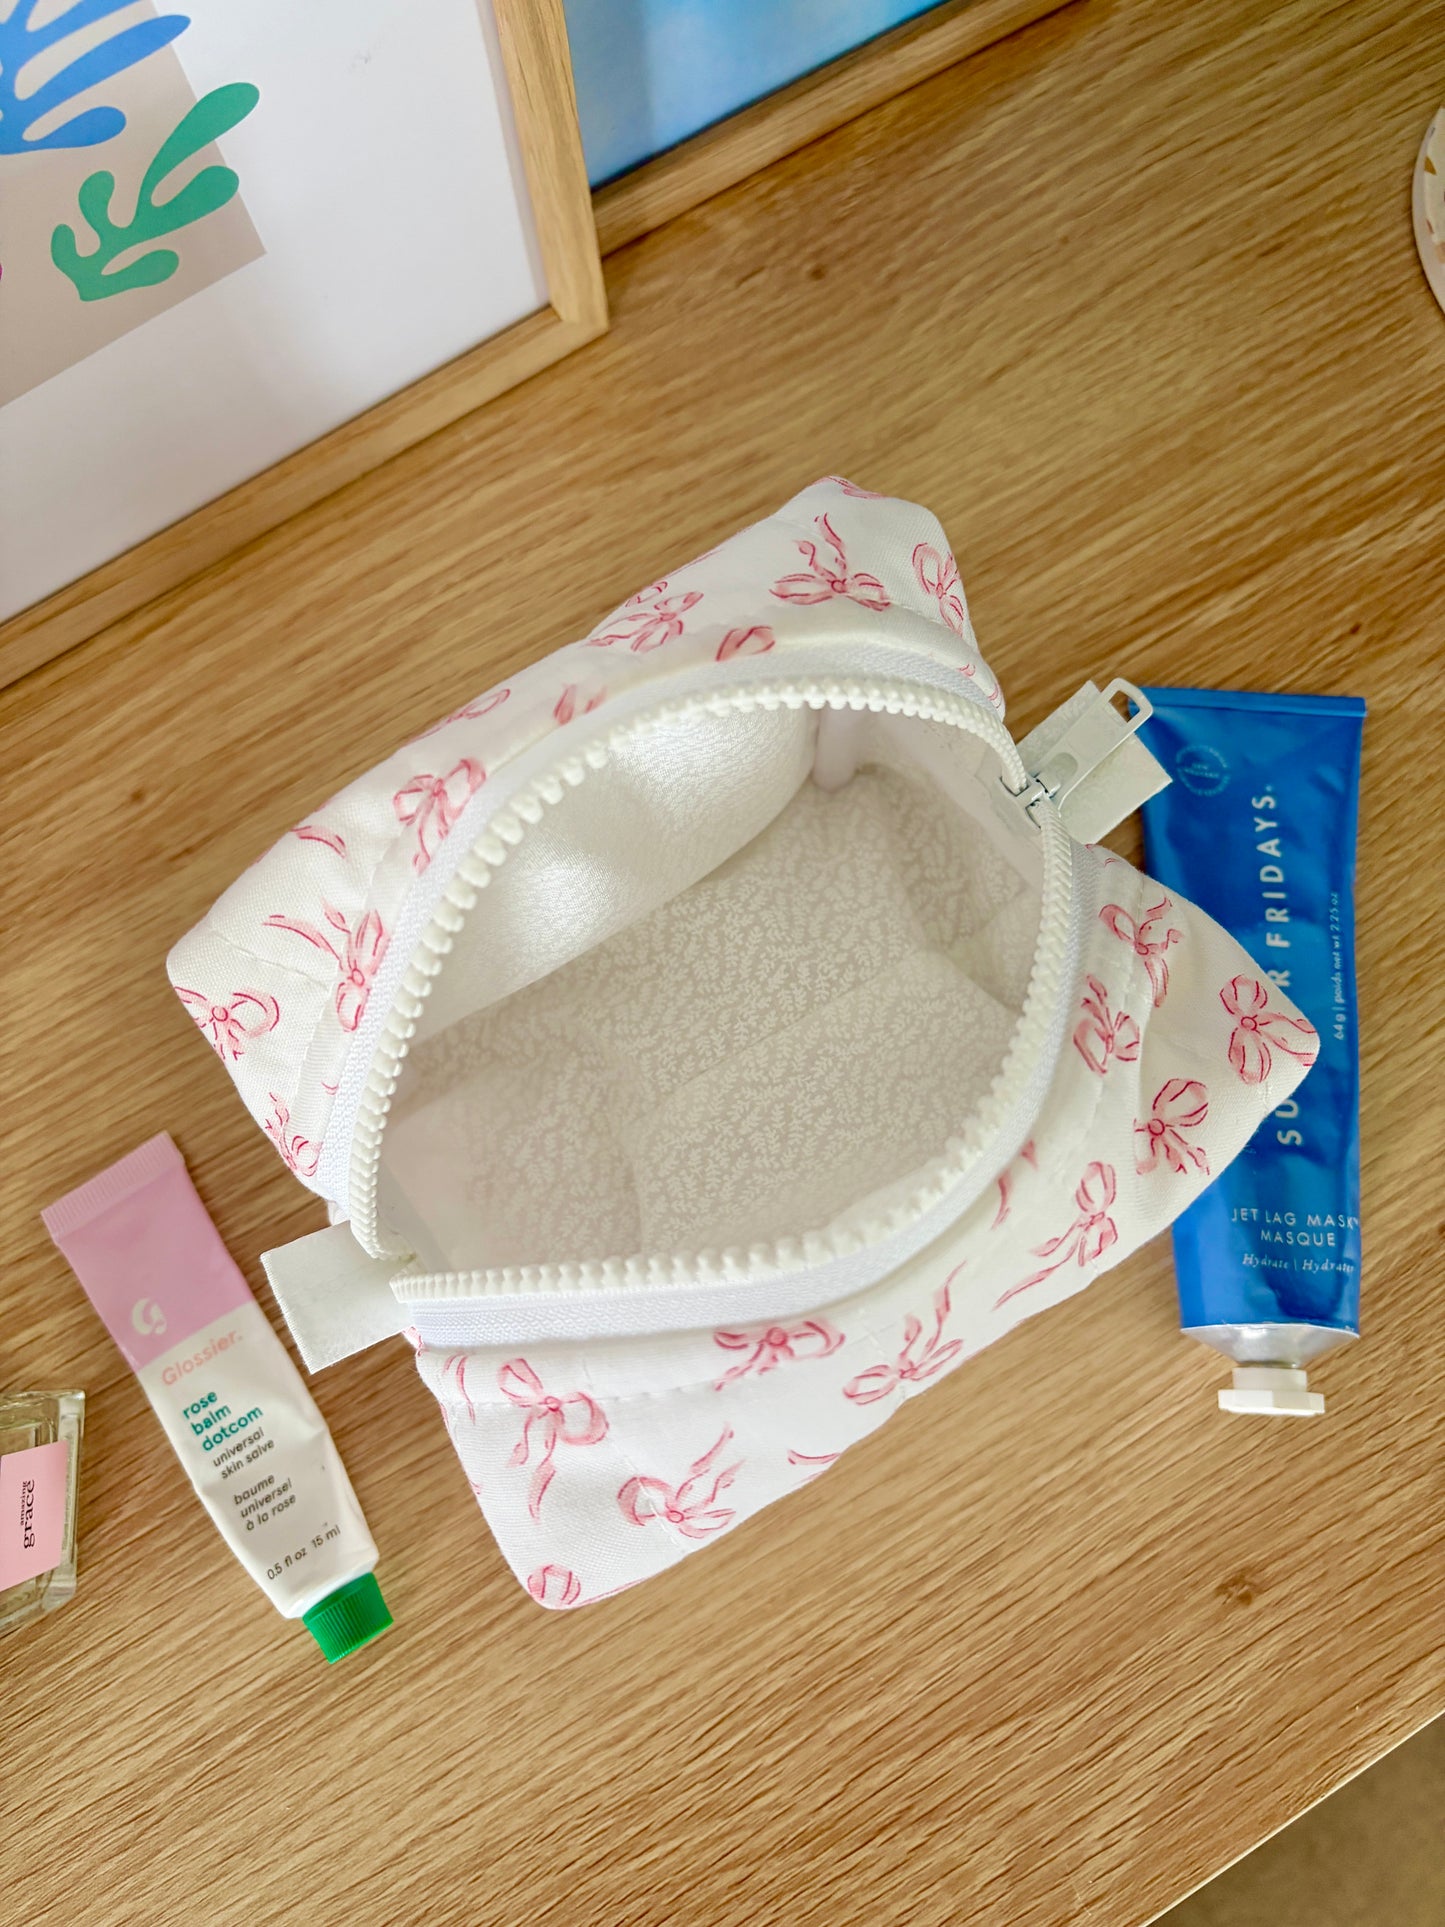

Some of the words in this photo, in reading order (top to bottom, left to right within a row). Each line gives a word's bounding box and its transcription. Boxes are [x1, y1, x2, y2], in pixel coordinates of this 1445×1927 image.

[1333, 1024, 1345, 1041] 64
[1266, 968, 1303, 1146] SUR
[1231, 1207, 1259, 1222] JET
[1264, 1209, 1297, 1227] LAG
[1260, 1229, 1336, 1248] MASQUE
[1242, 1252, 1289, 1269] Hydrate
[162, 1330, 244, 1386] Glossier.
[182, 1392, 218, 1420] rose
[191, 1405, 232, 1436] balm
[202, 1407, 264, 1451] dotcom
[212, 1426, 265, 1467] universal
[221, 1458, 245, 1480] skin
[246, 1439, 275, 1463] salve
[234, 1474, 276, 1506] baume
[240, 1477, 293, 1518] universel
[23, 1479, 35, 1549] grace
[245, 1517, 256, 1532] à
[257, 1511, 270, 1525] la
[272, 1494, 297, 1517] rose
[266, 1562, 284, 1581] 0.5
[284, 1554, 294, 1568] fl
[295, 1547, 308, 1560] oz
[310, 1534, 325, 1549] 15
[325, 1524, 342, 1541] ml
